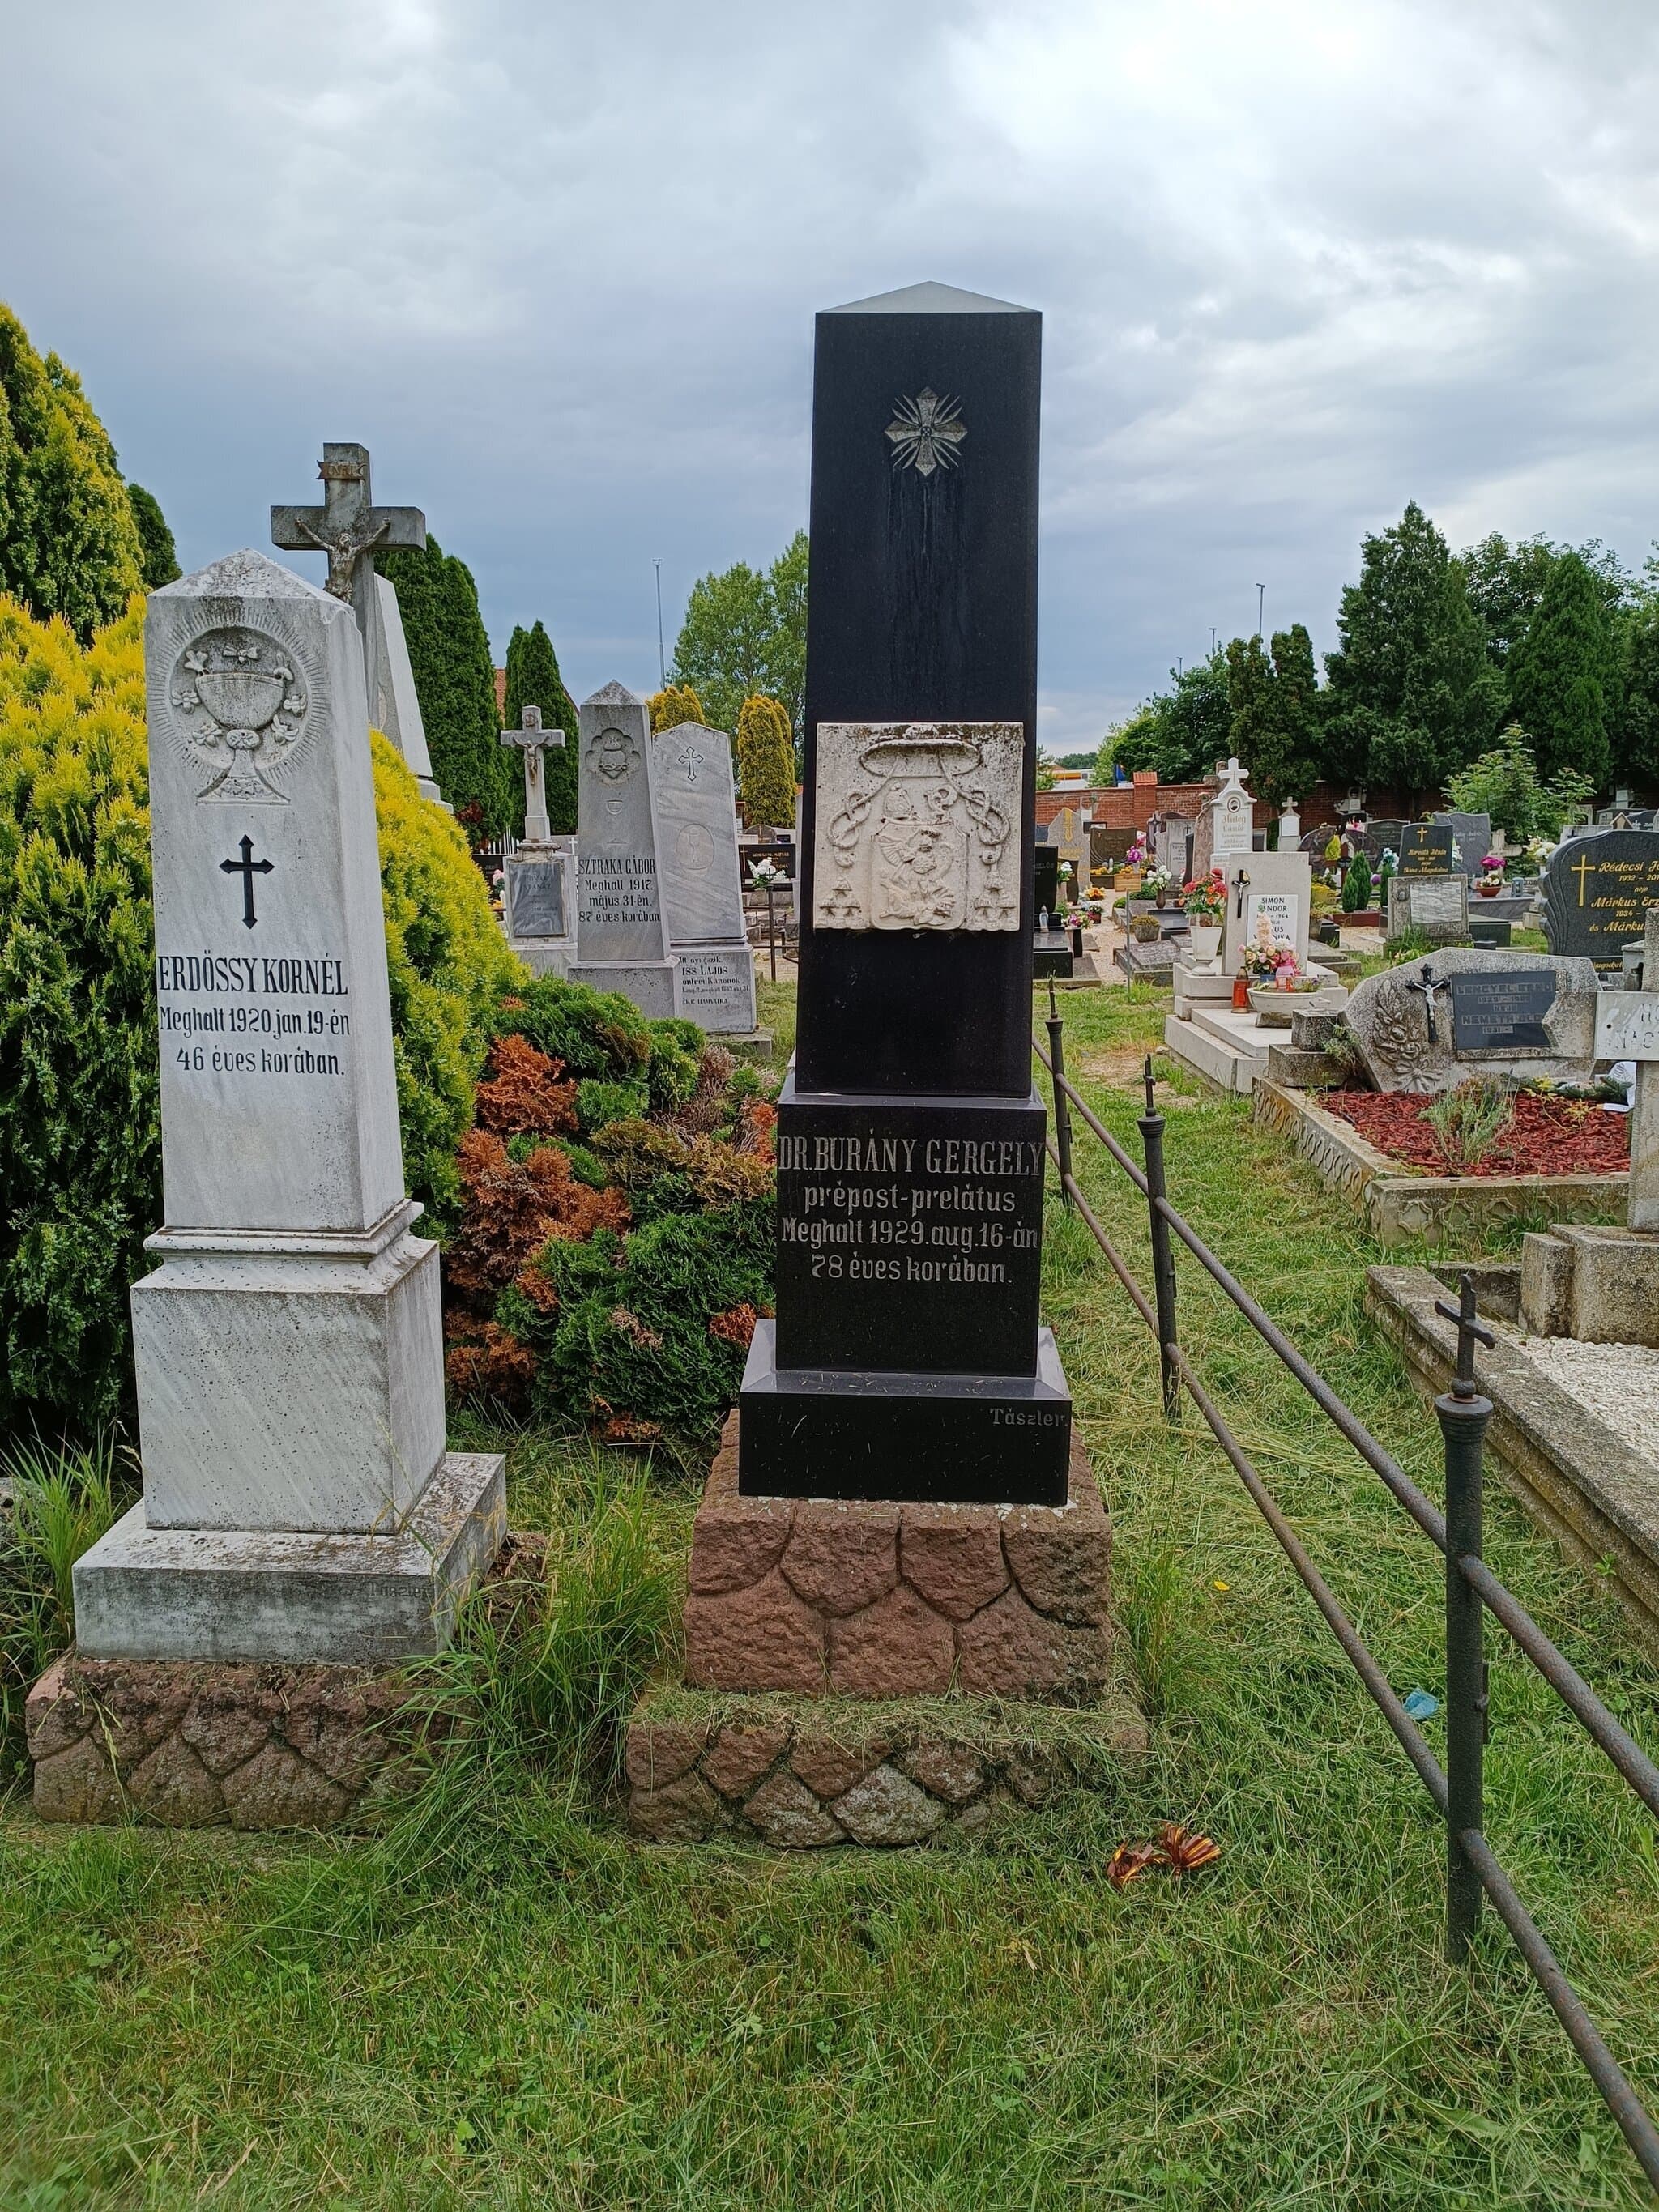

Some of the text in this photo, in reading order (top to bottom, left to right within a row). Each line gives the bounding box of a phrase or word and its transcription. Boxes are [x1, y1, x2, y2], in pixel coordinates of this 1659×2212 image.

[578, 855, 656, 875] SZTRAKA GÁBOR
[585, 880, 623, 893] Meghalt
[590, 895, 620, 910] május
[1590, 897, 1637, 908] Márkus
[596, 910, 619, 923] éves
[1616, 910, 1634, 918] 1934
[1589, 921, 1646, 932] és Márku
[158, 949, 348, 995] ERDÖSSY KORNÉL
[682, 965, 728, 976] ISS LAJOS
[160, 1006, 225, 1038] Meghalt
[177, 1045, 344, 1076] 46 éves korában.
[926, 1140, 1045, 1175] GERGELY
[804, 1180, 1016, 1215] prépost-prelátus
[781, 1217, 864, 1249] Meghalt
[812, 1251, 1013, 1284] 78 éves korában.
